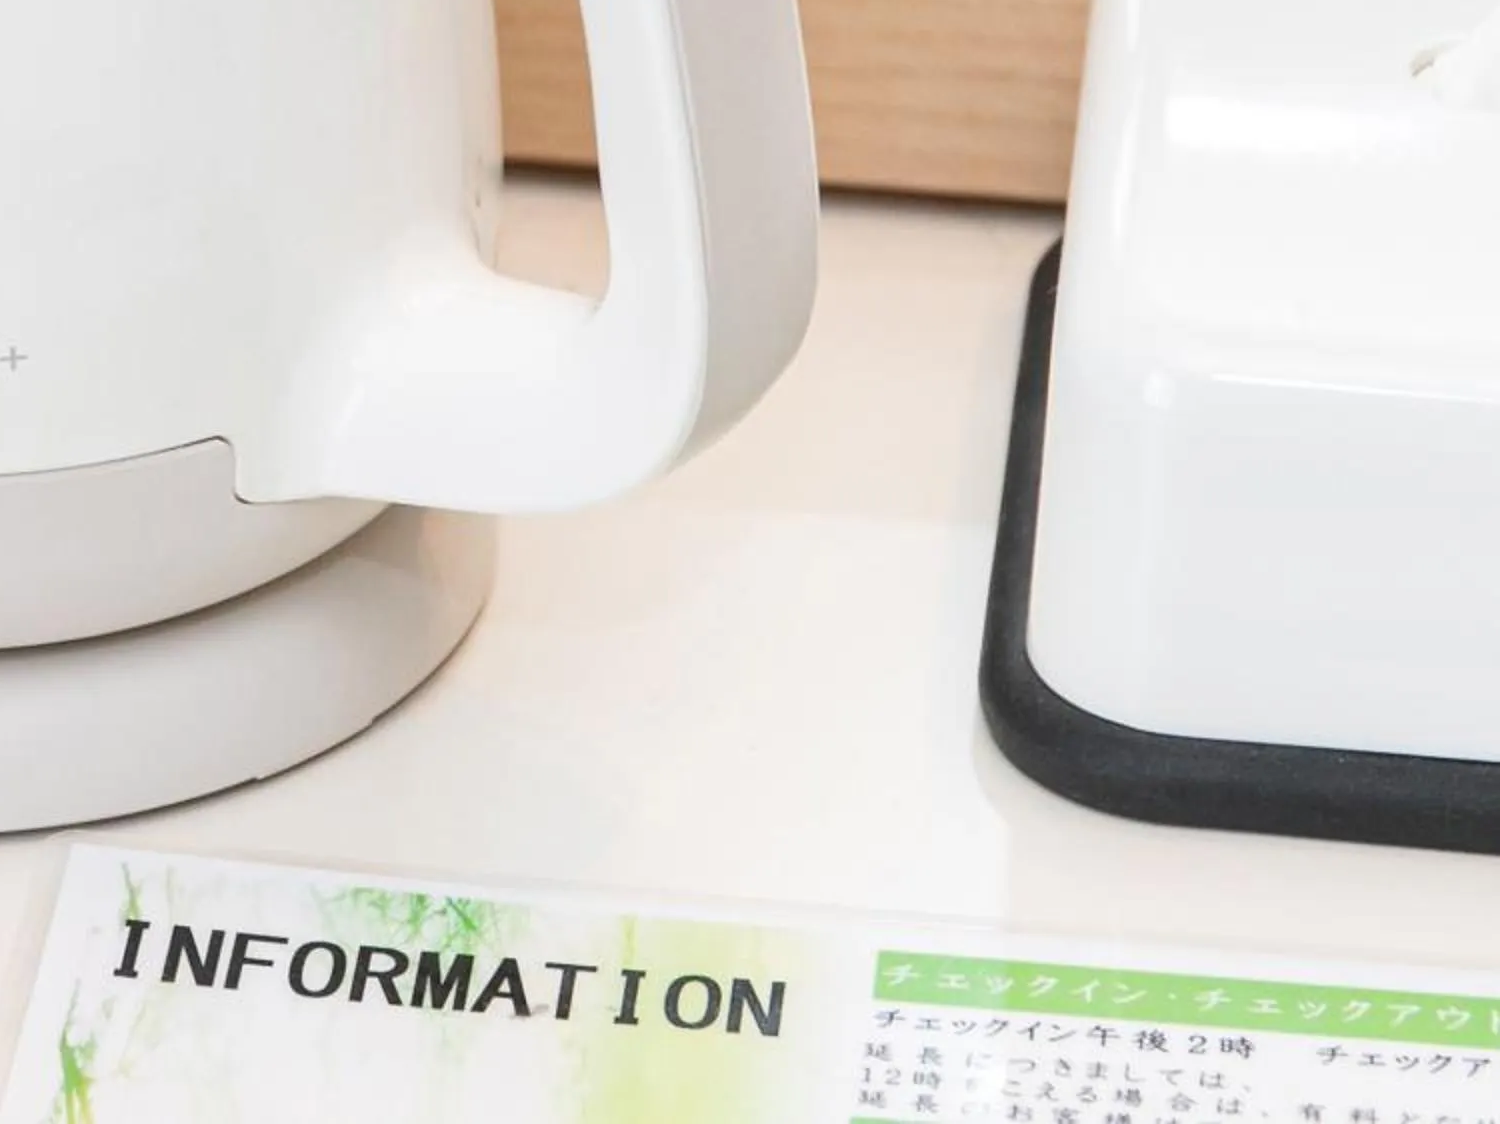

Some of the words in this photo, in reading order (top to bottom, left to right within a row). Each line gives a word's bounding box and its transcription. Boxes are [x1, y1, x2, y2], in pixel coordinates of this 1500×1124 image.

[113, 919, 787, 1038] INFORMATION
[1315, 1044, 1491, 1078] チェックア
